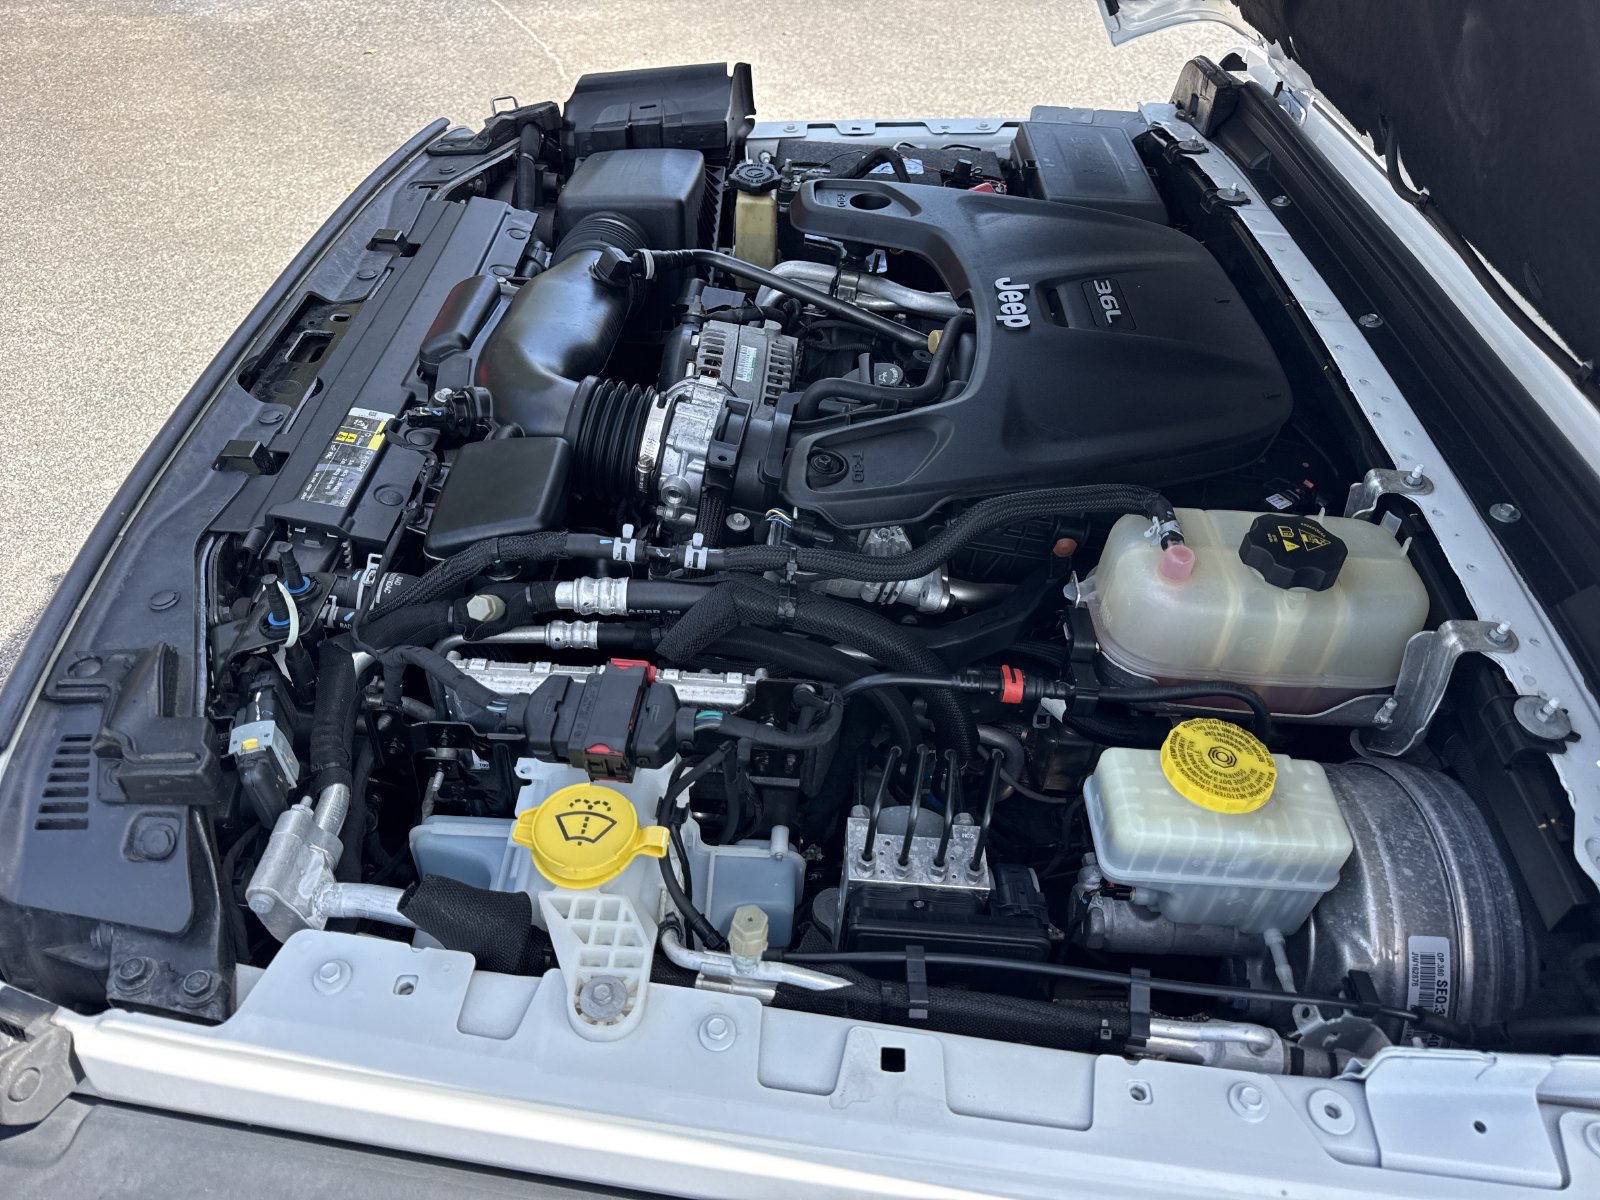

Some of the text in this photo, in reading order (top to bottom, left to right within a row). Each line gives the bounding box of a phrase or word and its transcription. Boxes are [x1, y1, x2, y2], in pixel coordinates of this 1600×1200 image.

[994, 277, 1031, 328] Jeep
[1094, 280, 1122, 324] 3.6L
[1434, 980, 1448, 1016] SEQ:3
